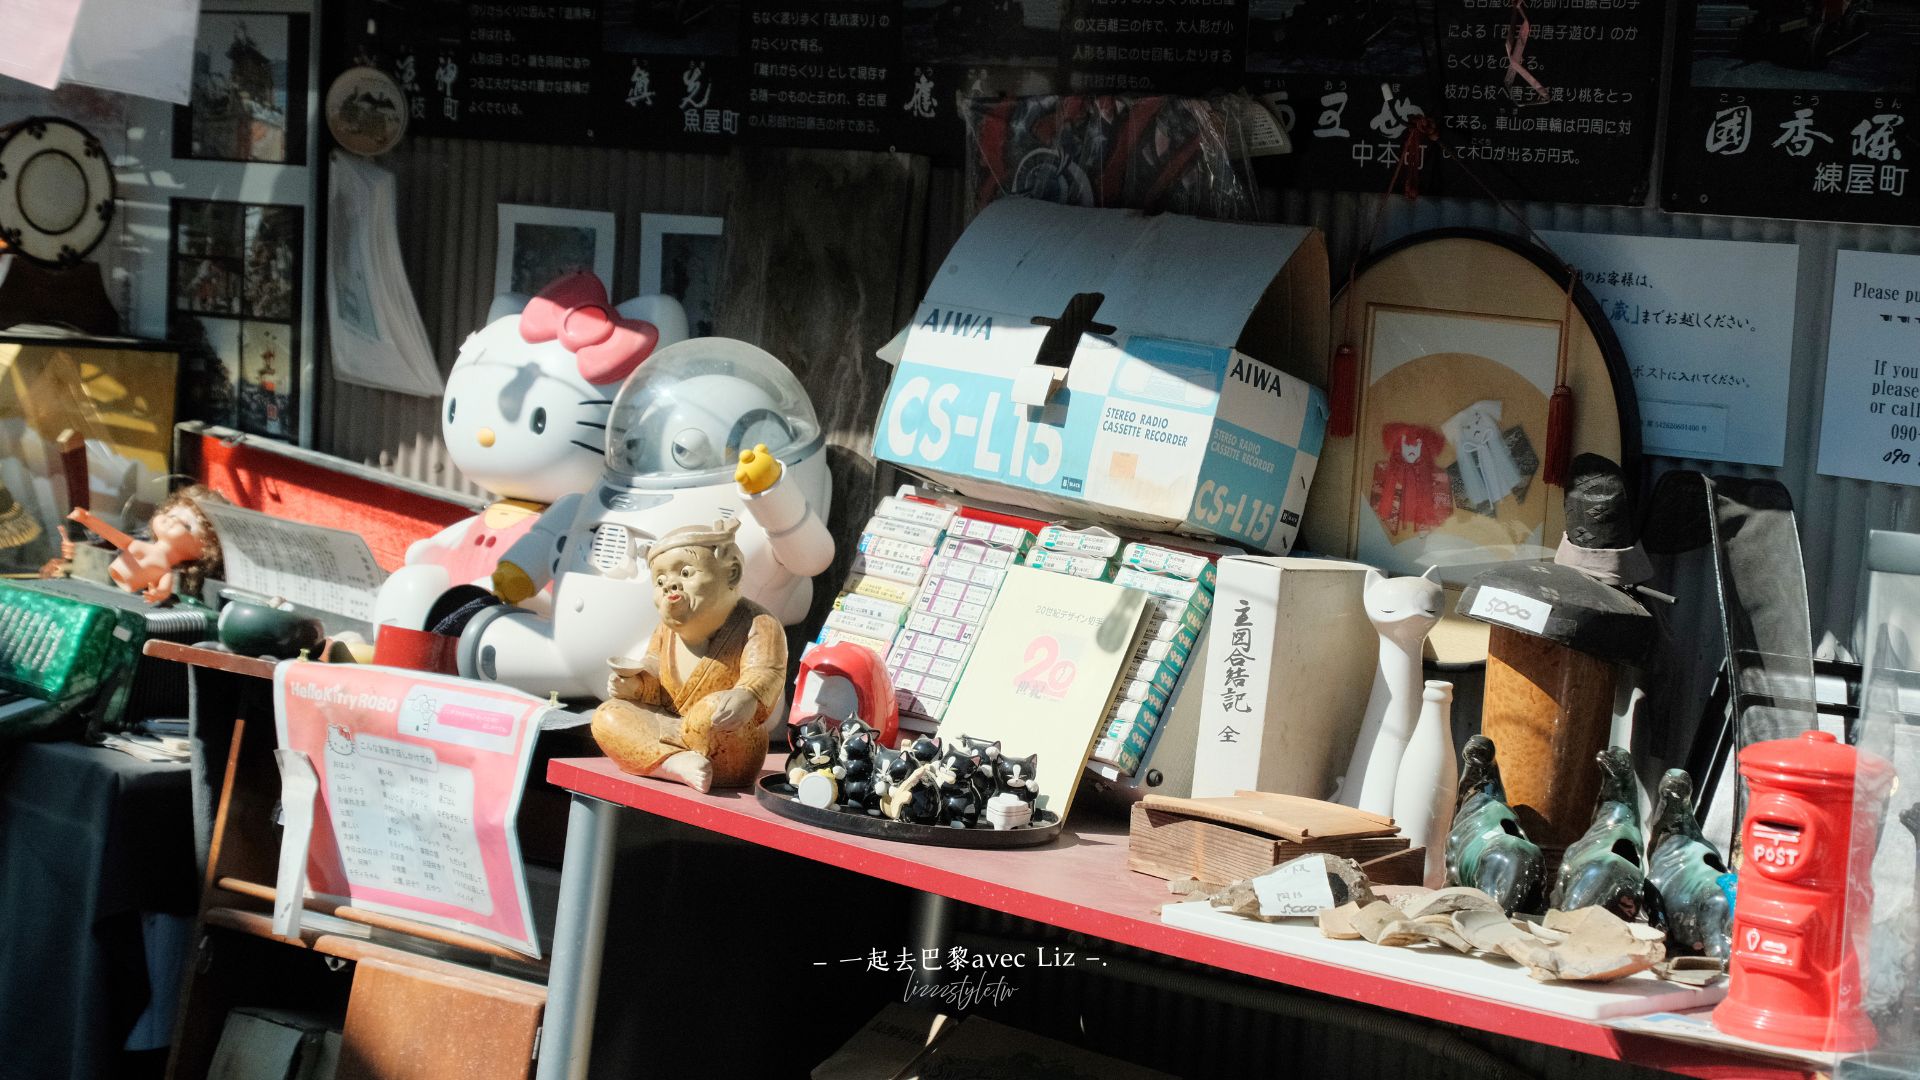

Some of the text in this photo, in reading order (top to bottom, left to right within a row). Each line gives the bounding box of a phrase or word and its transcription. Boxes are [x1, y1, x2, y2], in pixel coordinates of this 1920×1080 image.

[683, 109, 740, 136] 魚屋町
[1813, 162, 1910, 197] 練屋町
[1853, 281, 1899, 302] Please
[919, 308, 993, 341] AIWA
[1600, 299, 1756, 333] 「蔵」までお越しください。
[1230, 358, 1282, 398] AIWA
[1874, 360, 1919, 379] If you
[1872, 380, 1919, 399] please
[1105, 406, 1169, 429] STEREO RADIO
[1870, 401, 1920, 418] or call
[887, 376, 1063, 485] CS-L15
[1102, 420, 1188, 448] CASSETTE RECORDER
[1213, 429, 1261, 456] STEREO RADIO
[1210, 439, 1276, 474] CASSETTE RECORDER
[1194, 479, 1275, 542] CS-L15
[1217, 725, 1241, 743] 全
[1753, 843, 1798, 866] POST
